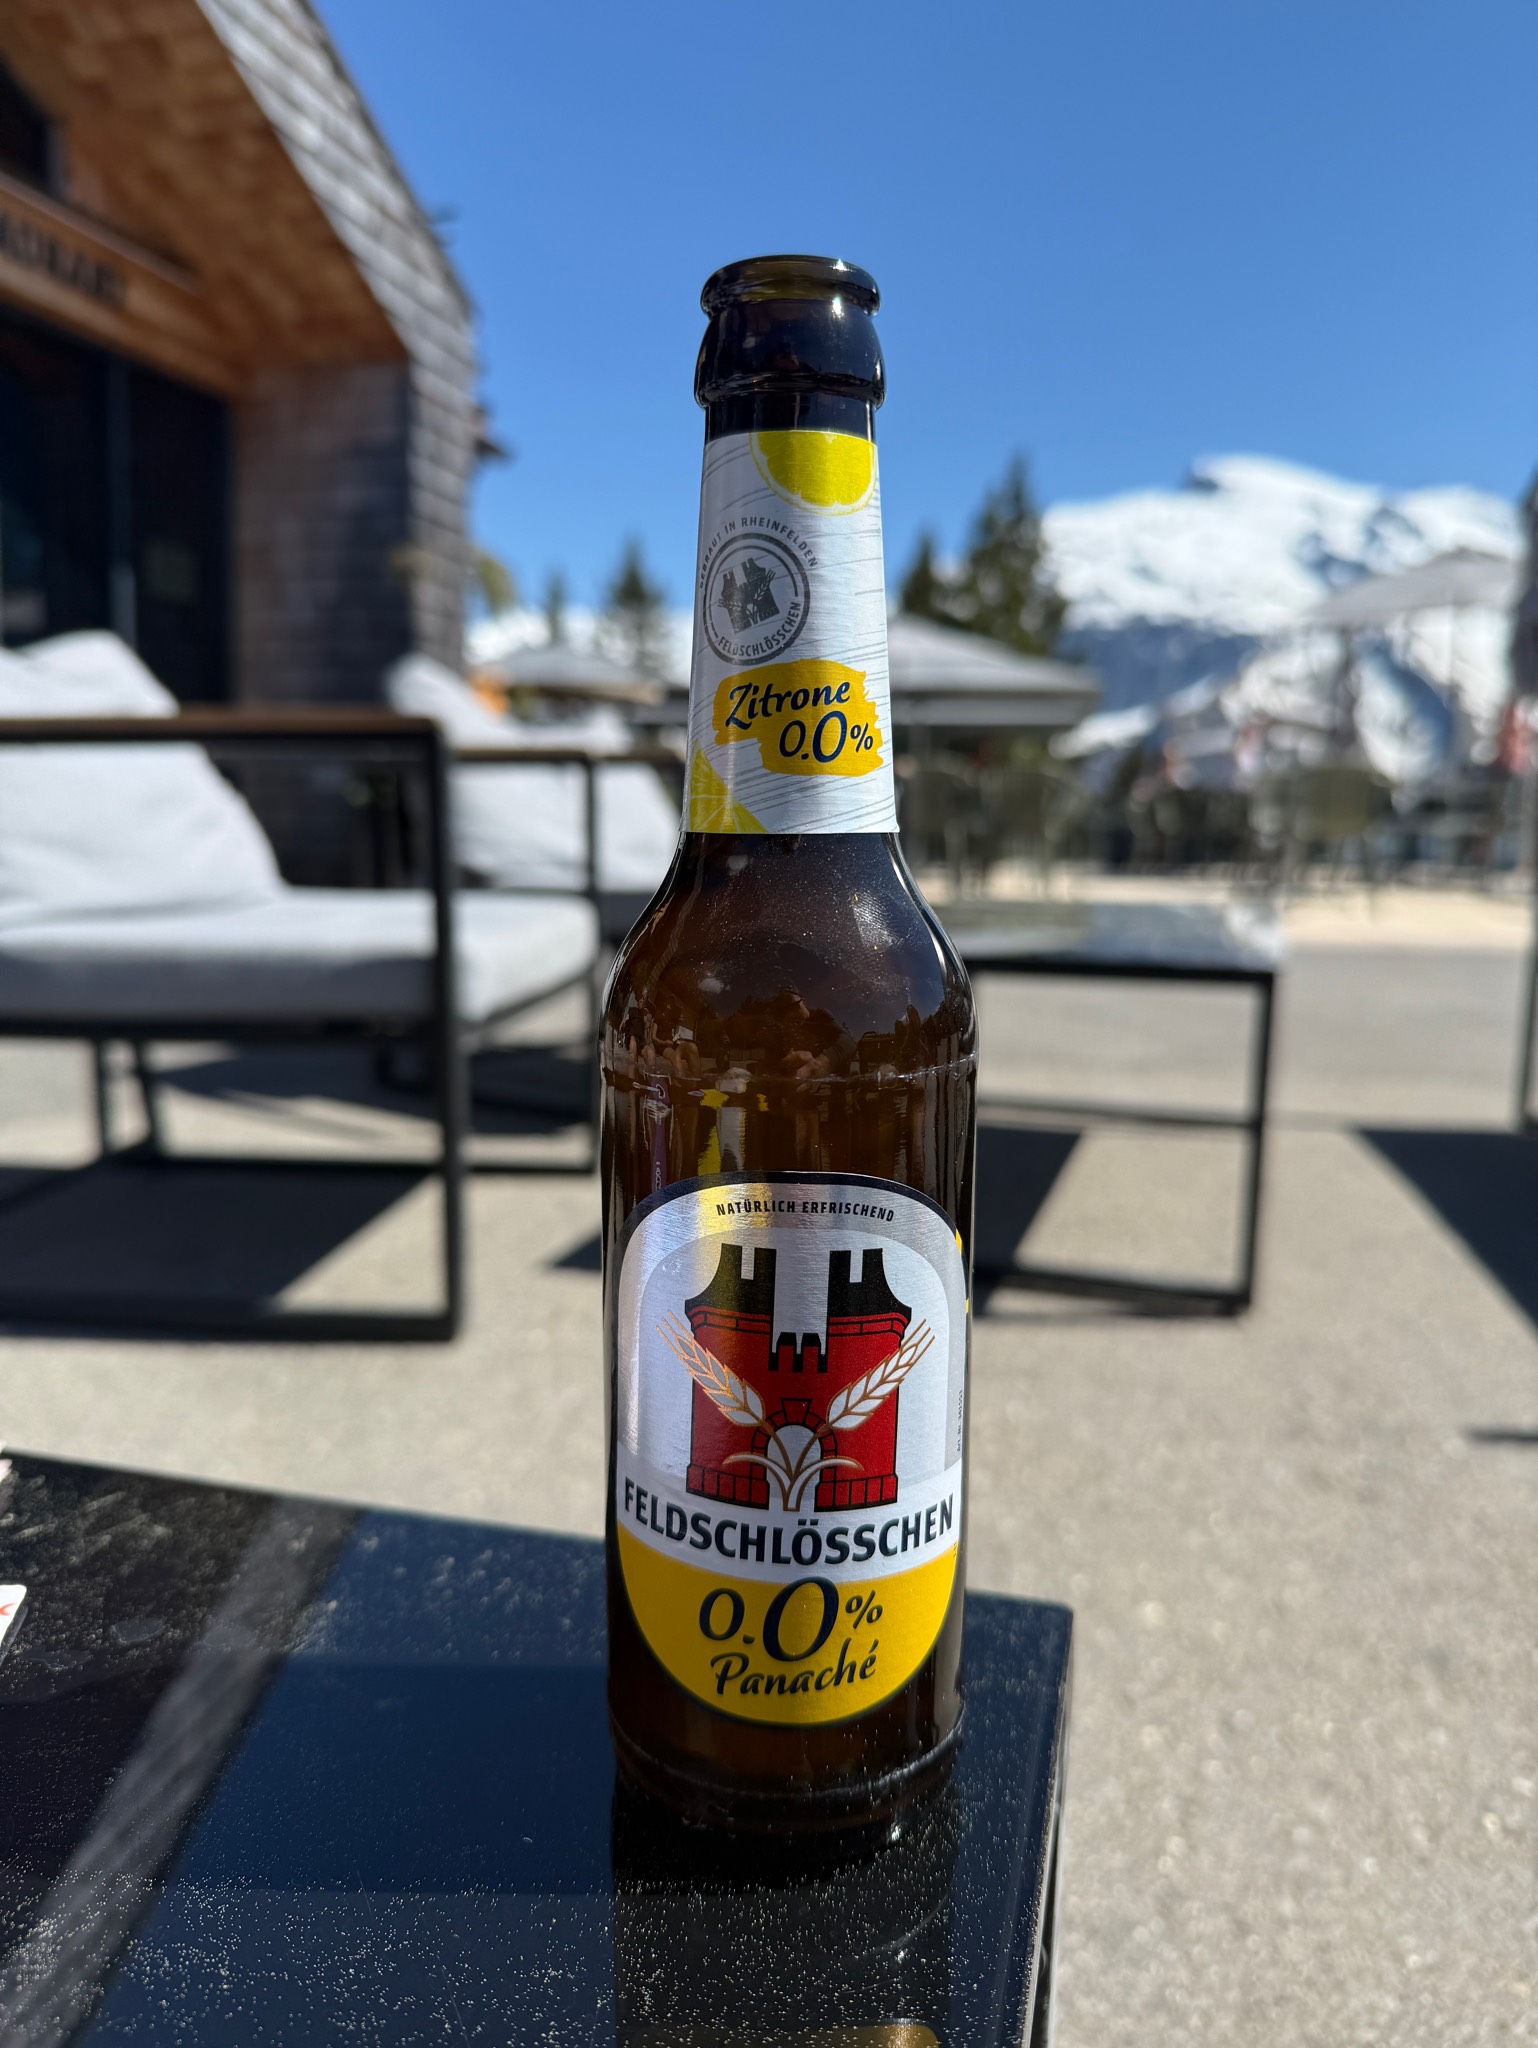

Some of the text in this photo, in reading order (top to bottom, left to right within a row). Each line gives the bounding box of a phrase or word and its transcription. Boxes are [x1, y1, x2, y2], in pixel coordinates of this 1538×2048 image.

[724, 521, 736, 534] IN
[741, 517, 819, 567] RHEINFELDEN
[718, 601, 802, 657] FELDSCHLÖSSCHEN
[725, 681, 850, 730] Zitrone
[716, 1199, 895, 1222] NATÜRLICH ERFRISCHEND
[625, 1476, 954, 1565] FELDSCHLÖSSCHEN
[710, 1637, 880, 1695] Panaché
